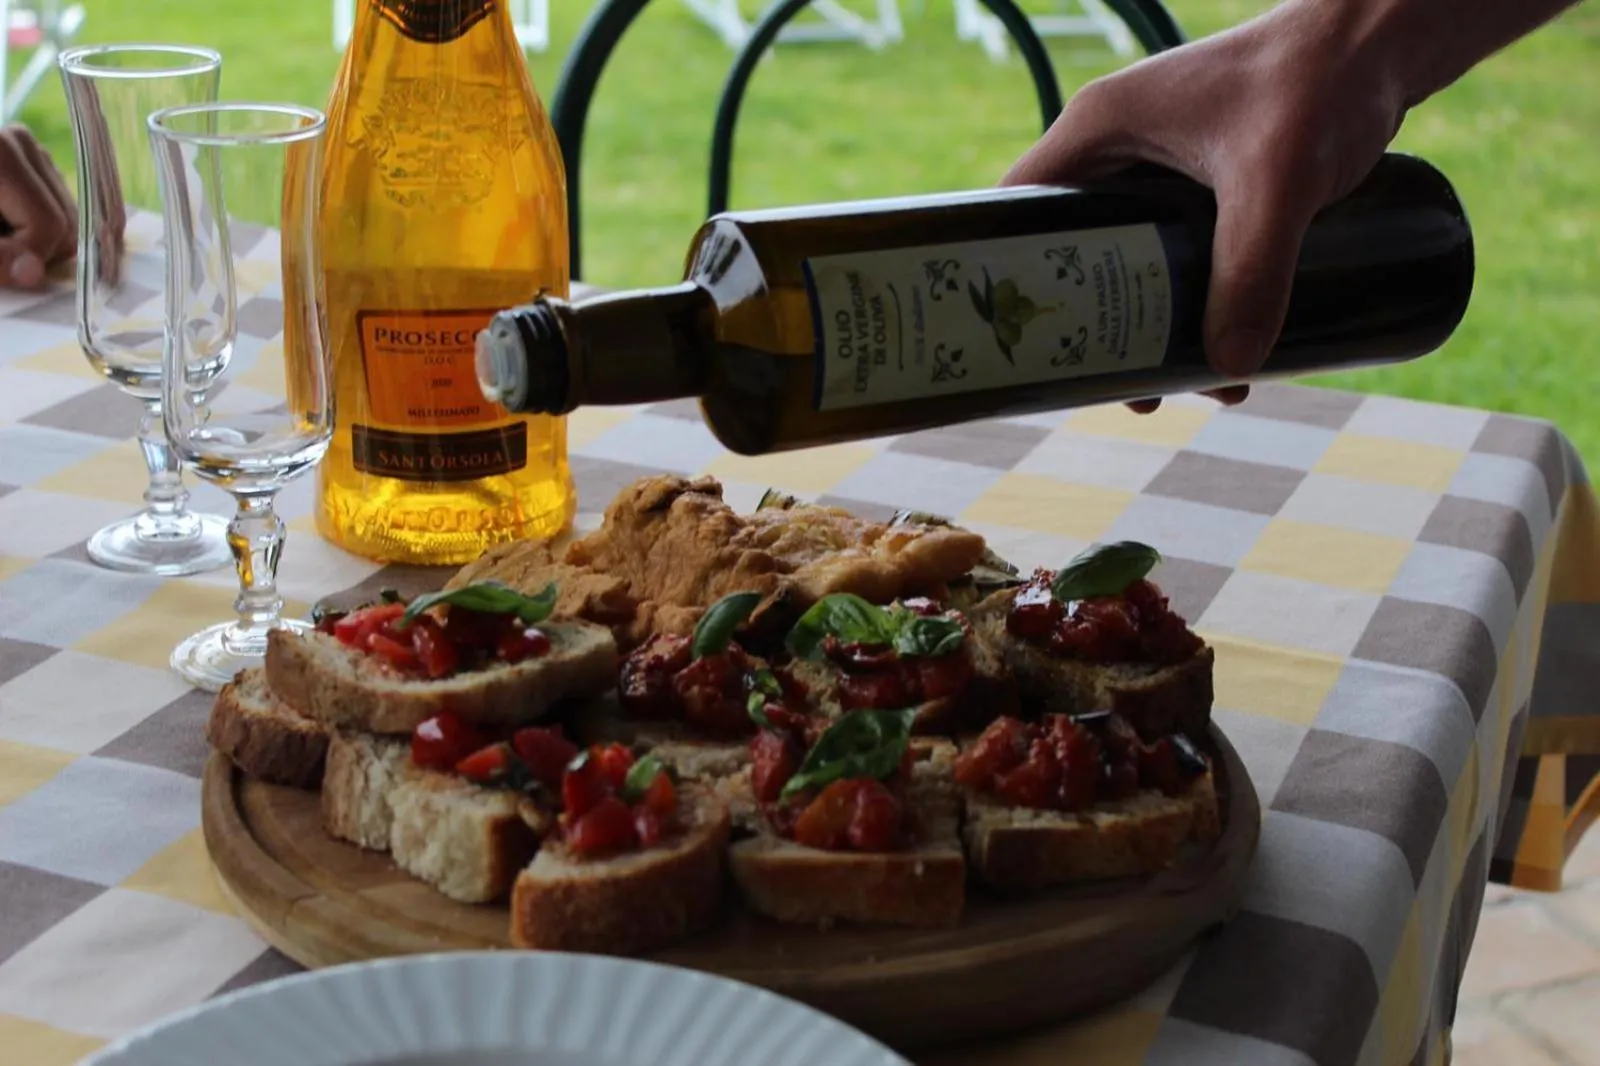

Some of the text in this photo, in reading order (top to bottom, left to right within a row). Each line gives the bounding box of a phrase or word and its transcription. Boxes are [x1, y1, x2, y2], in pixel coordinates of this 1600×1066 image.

[373, 327, 479, 347] PROSEC
[835, 310, 852, 358] OLIO
[846, 271, 869, 393] EXTRA VERGINE
[870, 295, 886, 365] DI OLIVA
